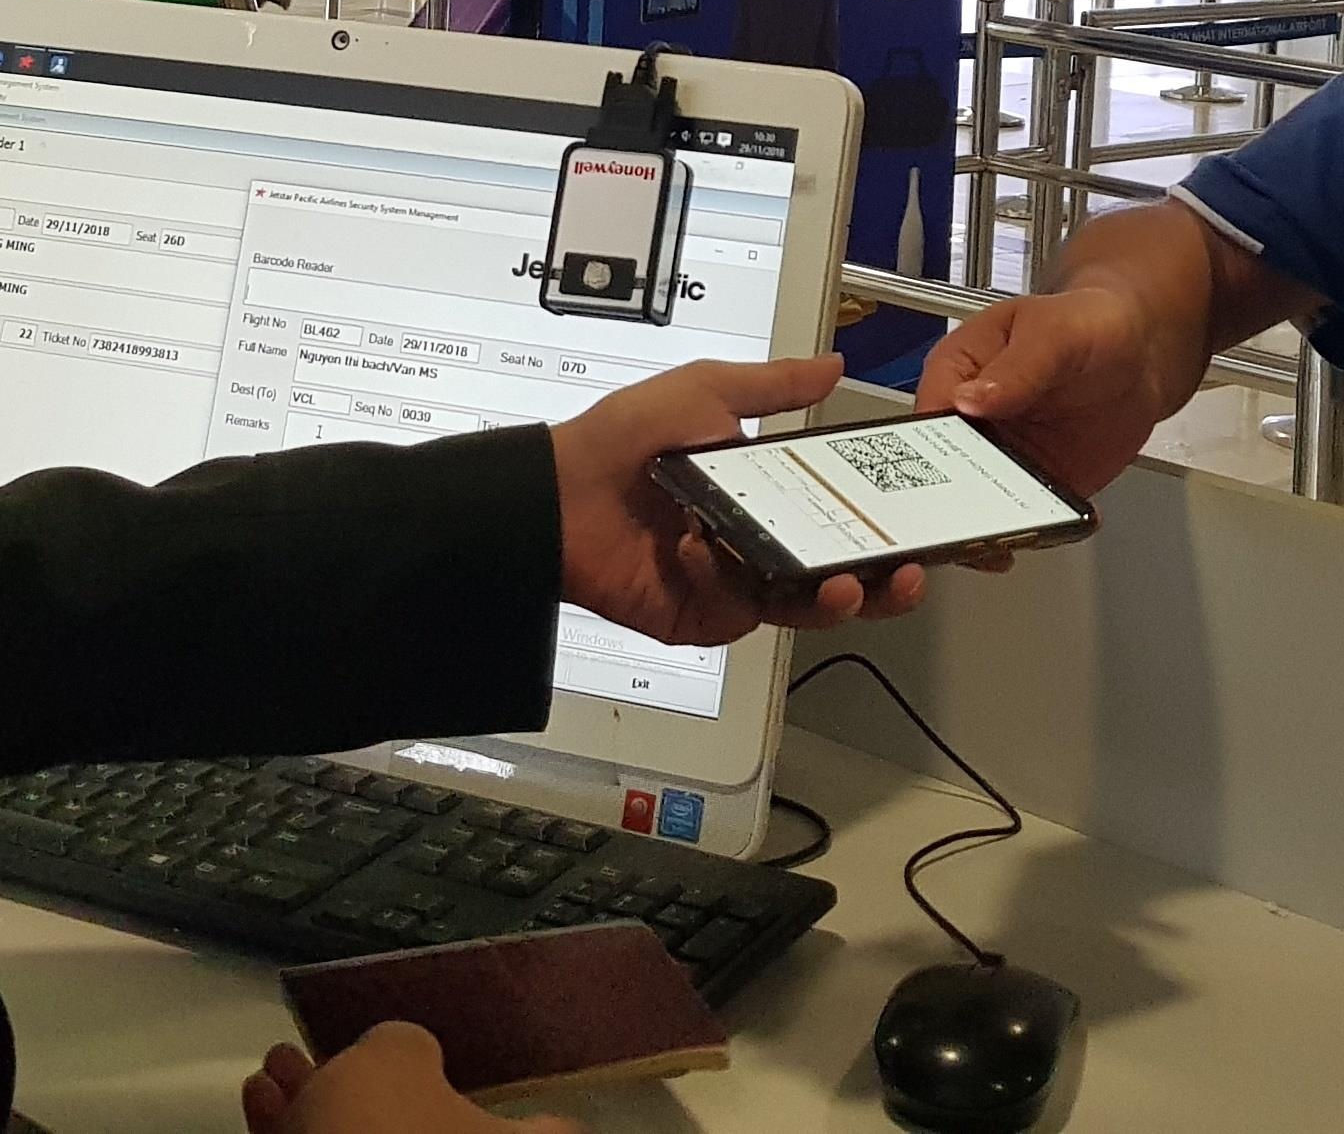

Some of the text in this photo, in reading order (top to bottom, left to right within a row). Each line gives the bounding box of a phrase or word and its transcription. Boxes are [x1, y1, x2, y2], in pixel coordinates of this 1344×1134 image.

[19, 140, 25, 151] 1
[574, 160, 656, 181] Honeywell
[269, 190, 459, 222] Jetstar Pacific Airlines Security System Management
[18, 215, 40, 228] Date
[46, 218, 111, 237] 29/11/2018
[136, 230, 158, 243] Seat
[163, 233, 185, 247] 26D
[6, 239, 36, 253] MING
[252, 252, 334, 274] Barcode Reader
[19, 327, 33, 340] 22
[43, 331, 70, 346] Ticket
[72, 335, 87, 348] No
[242, 312, 587, 375] Flight No BL462 Date 29/11/2018 Seat No 07D
[238, 339, 438, 379] Full Name Nguyen thi bach/Van MS
[230, 382, 254, 396] Dest
[256, 386, 277, 402] (To)
[292, 392, 316, 406] VCL
[355, 401, 375, 417] Seq
[378, 405, 393, 417] No
[225, 413, 270, 431] Remarks
[562, 626, 624, 650] Windows
[632, 677, 650, 690] Exit
